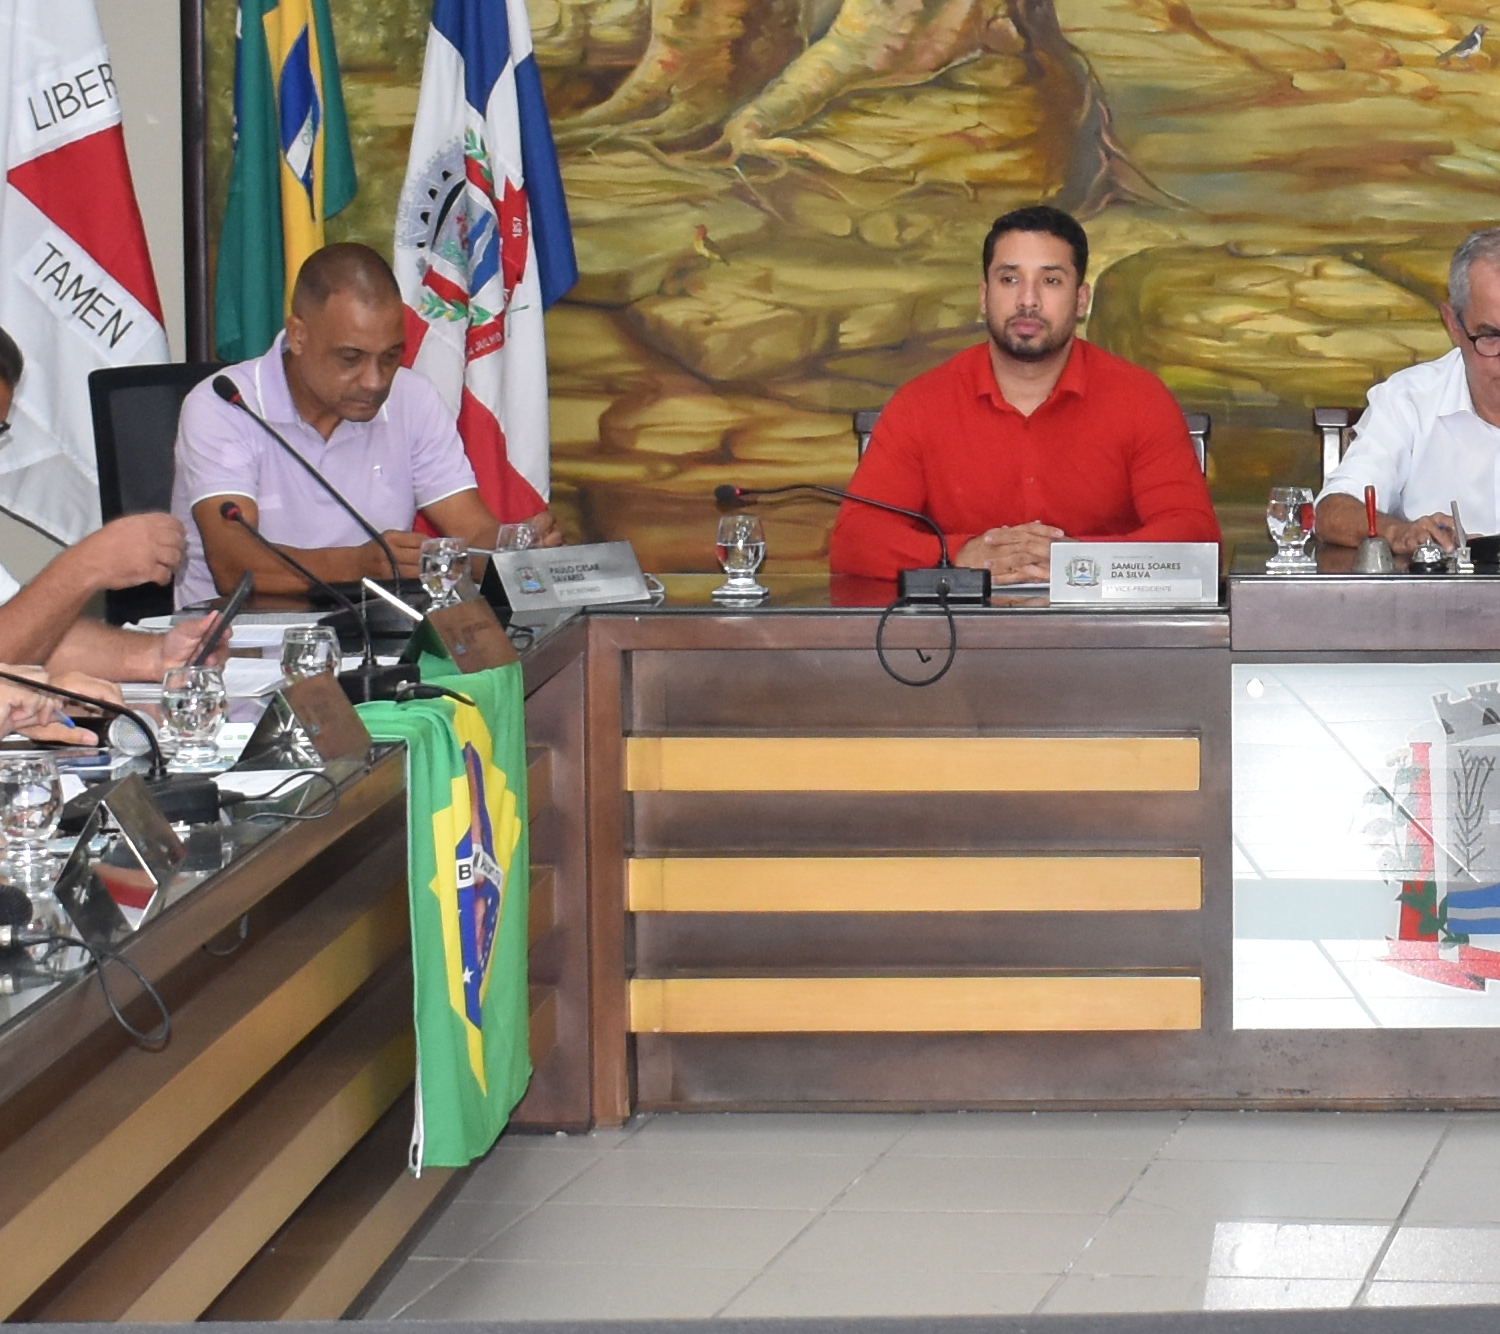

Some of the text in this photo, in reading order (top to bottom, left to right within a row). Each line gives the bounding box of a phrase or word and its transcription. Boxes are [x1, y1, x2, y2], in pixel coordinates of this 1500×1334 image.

[32, 241, 133, 349] TAMEN
[1111, 562, 1181, 570] SAMUEL SOARES
